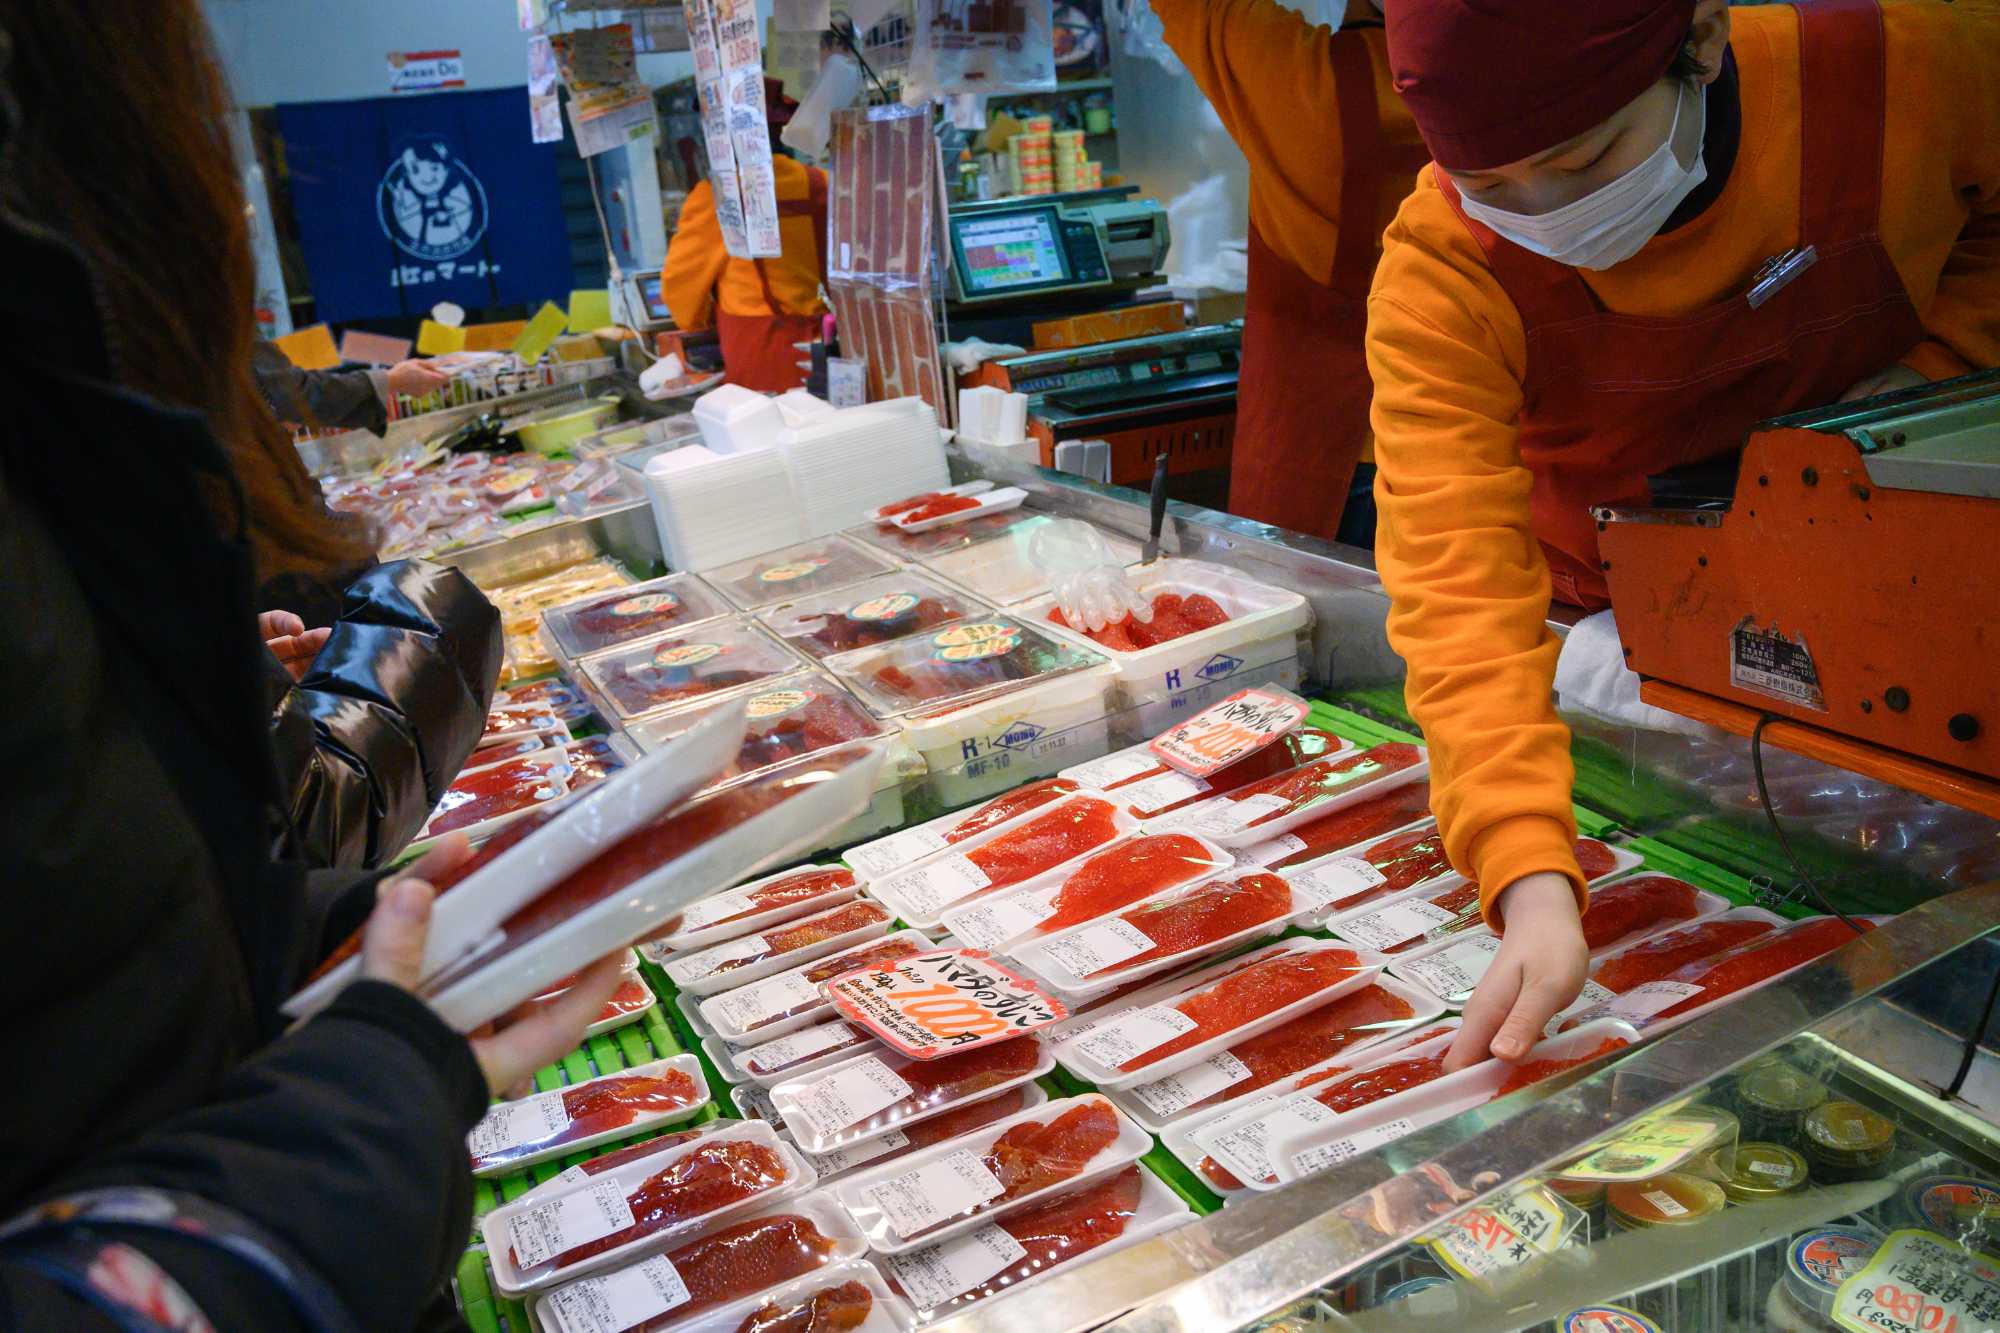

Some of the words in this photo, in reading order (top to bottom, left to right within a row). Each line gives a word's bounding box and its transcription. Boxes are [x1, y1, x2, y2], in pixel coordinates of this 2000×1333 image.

[917, 954, 1054, 1026] ハマダのすじこ
